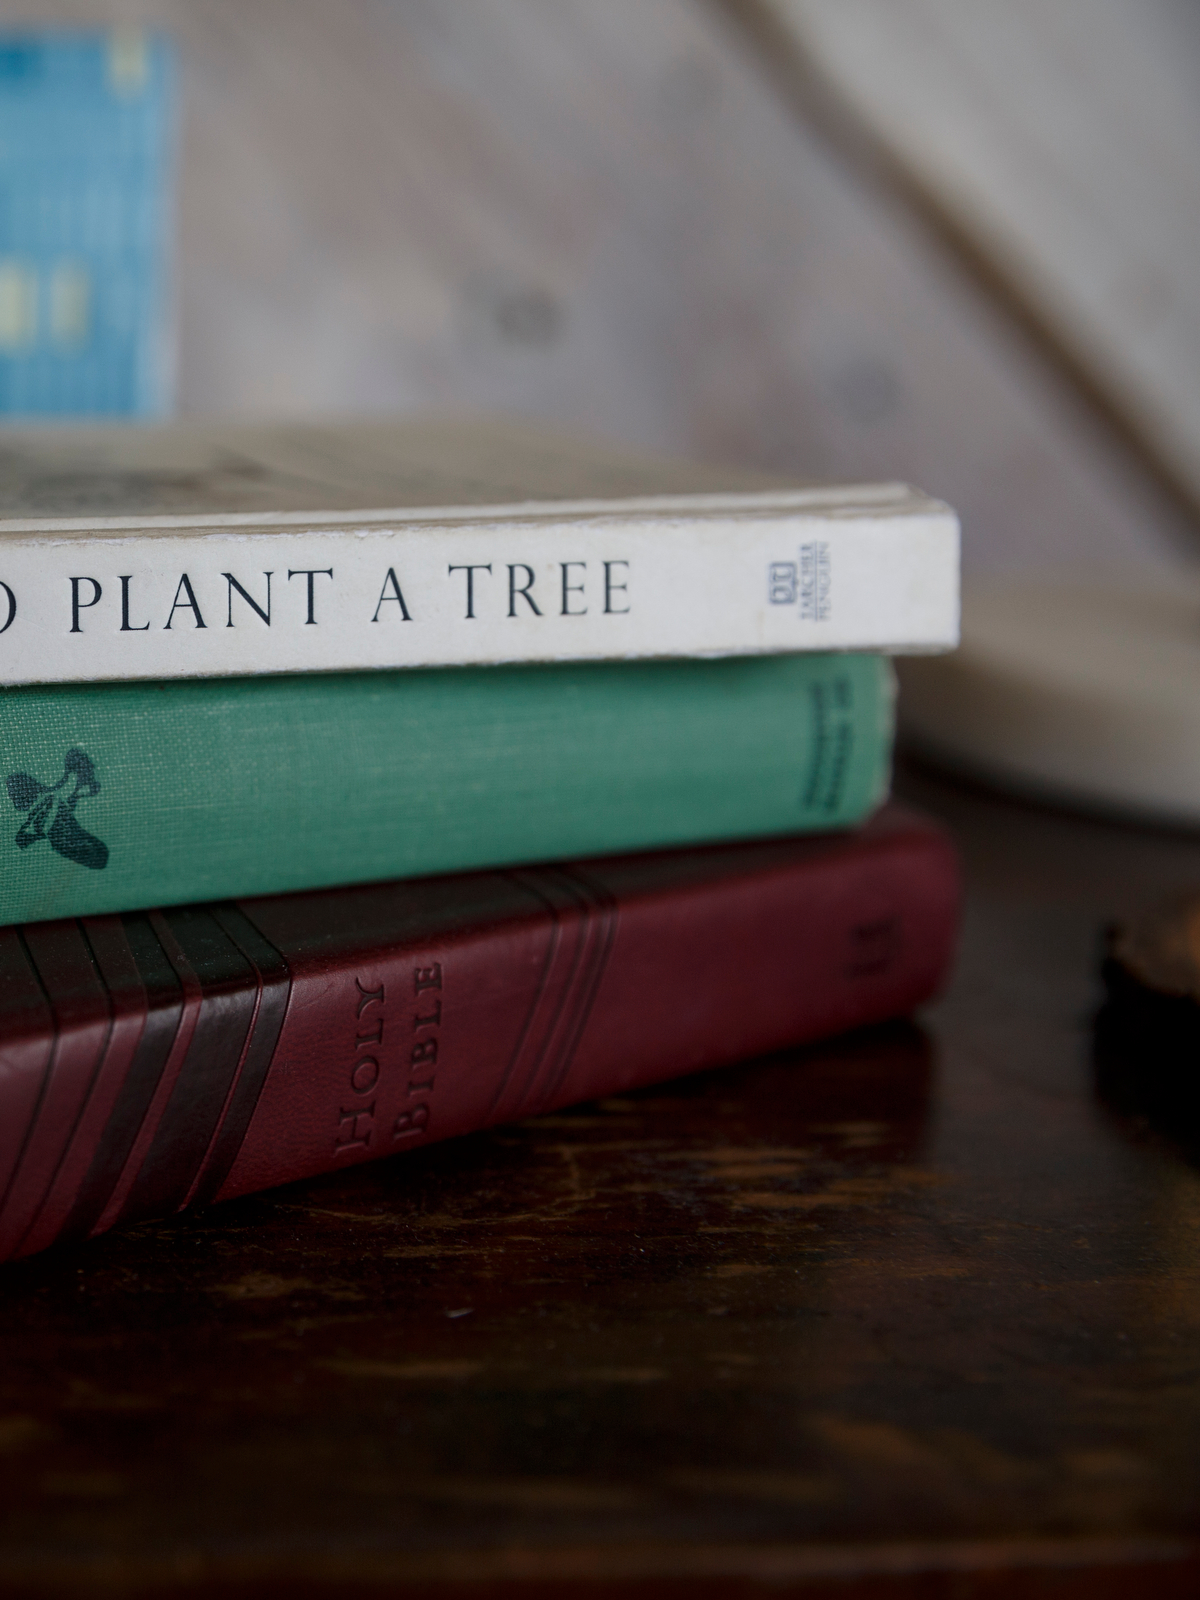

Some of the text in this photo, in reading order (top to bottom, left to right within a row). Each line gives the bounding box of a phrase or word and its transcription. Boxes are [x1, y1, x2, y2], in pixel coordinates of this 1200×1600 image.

[68, 567, 334, 633] PLANT
[370, 567, 414, 622] A
[447, 560, 632, 618] TREE
[334, 976, 386, 1156] HOLY
[392, 962, 443, 1140] BIBLE
